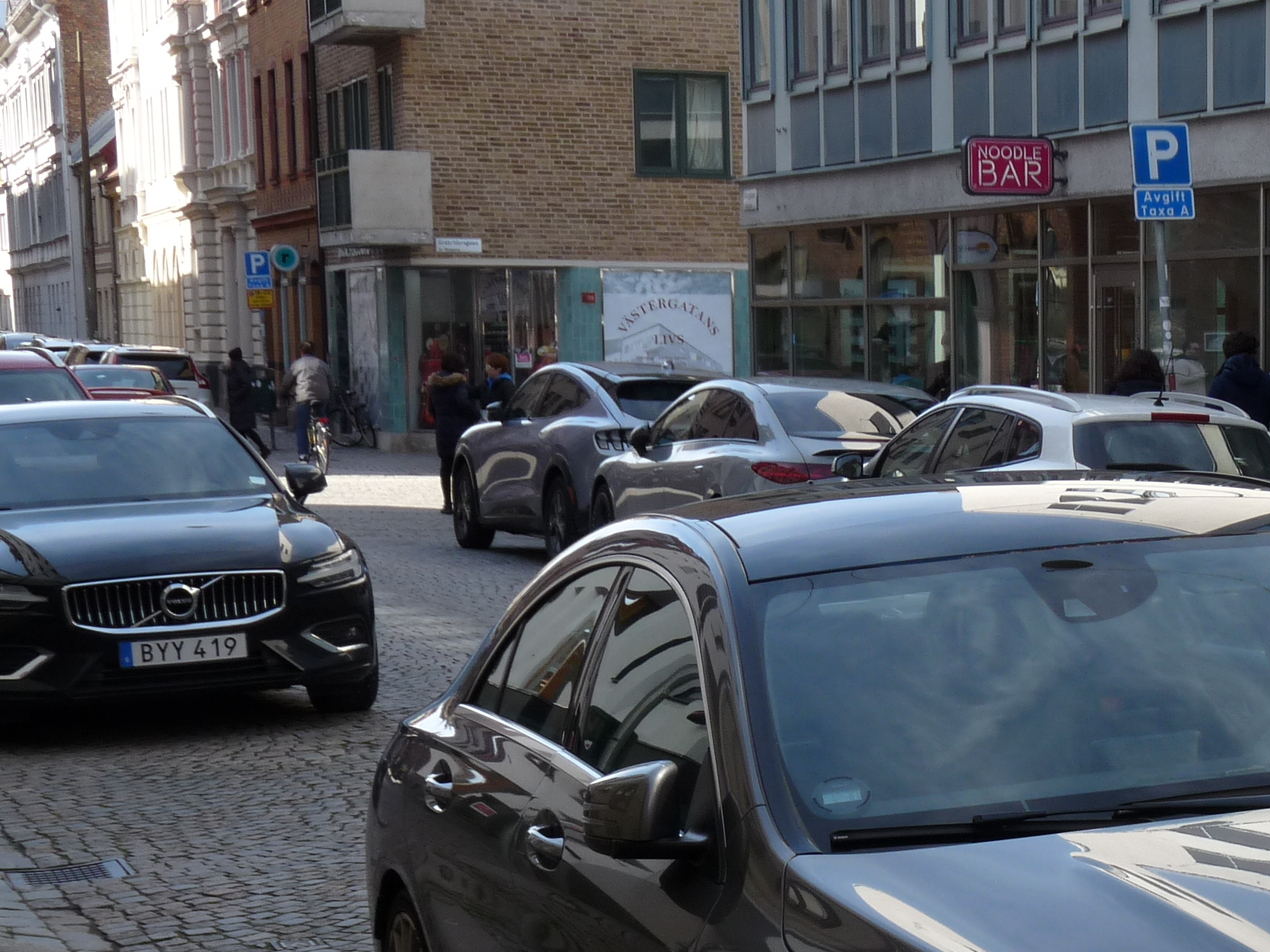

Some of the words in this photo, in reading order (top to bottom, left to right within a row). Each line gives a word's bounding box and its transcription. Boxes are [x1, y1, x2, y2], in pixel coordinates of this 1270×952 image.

[978, 145, 1042, 160] NOODLE
[1146, 130, 1178, 180] P
[978, 160, 1042, 187] BAR
[1144, 191, 1185, 204] Avgift
[1141, 205, 1174, 216] Taxa
[1181, 205, 1189, 216] A
[250, 254, 265, 274] P
[618, 298, 719, 336] VÄSTERGATANS
[653, 334, 685, 345] LIVS
[140, 641, 184, 662] BYY
[194, 637, 237, 658] 419
